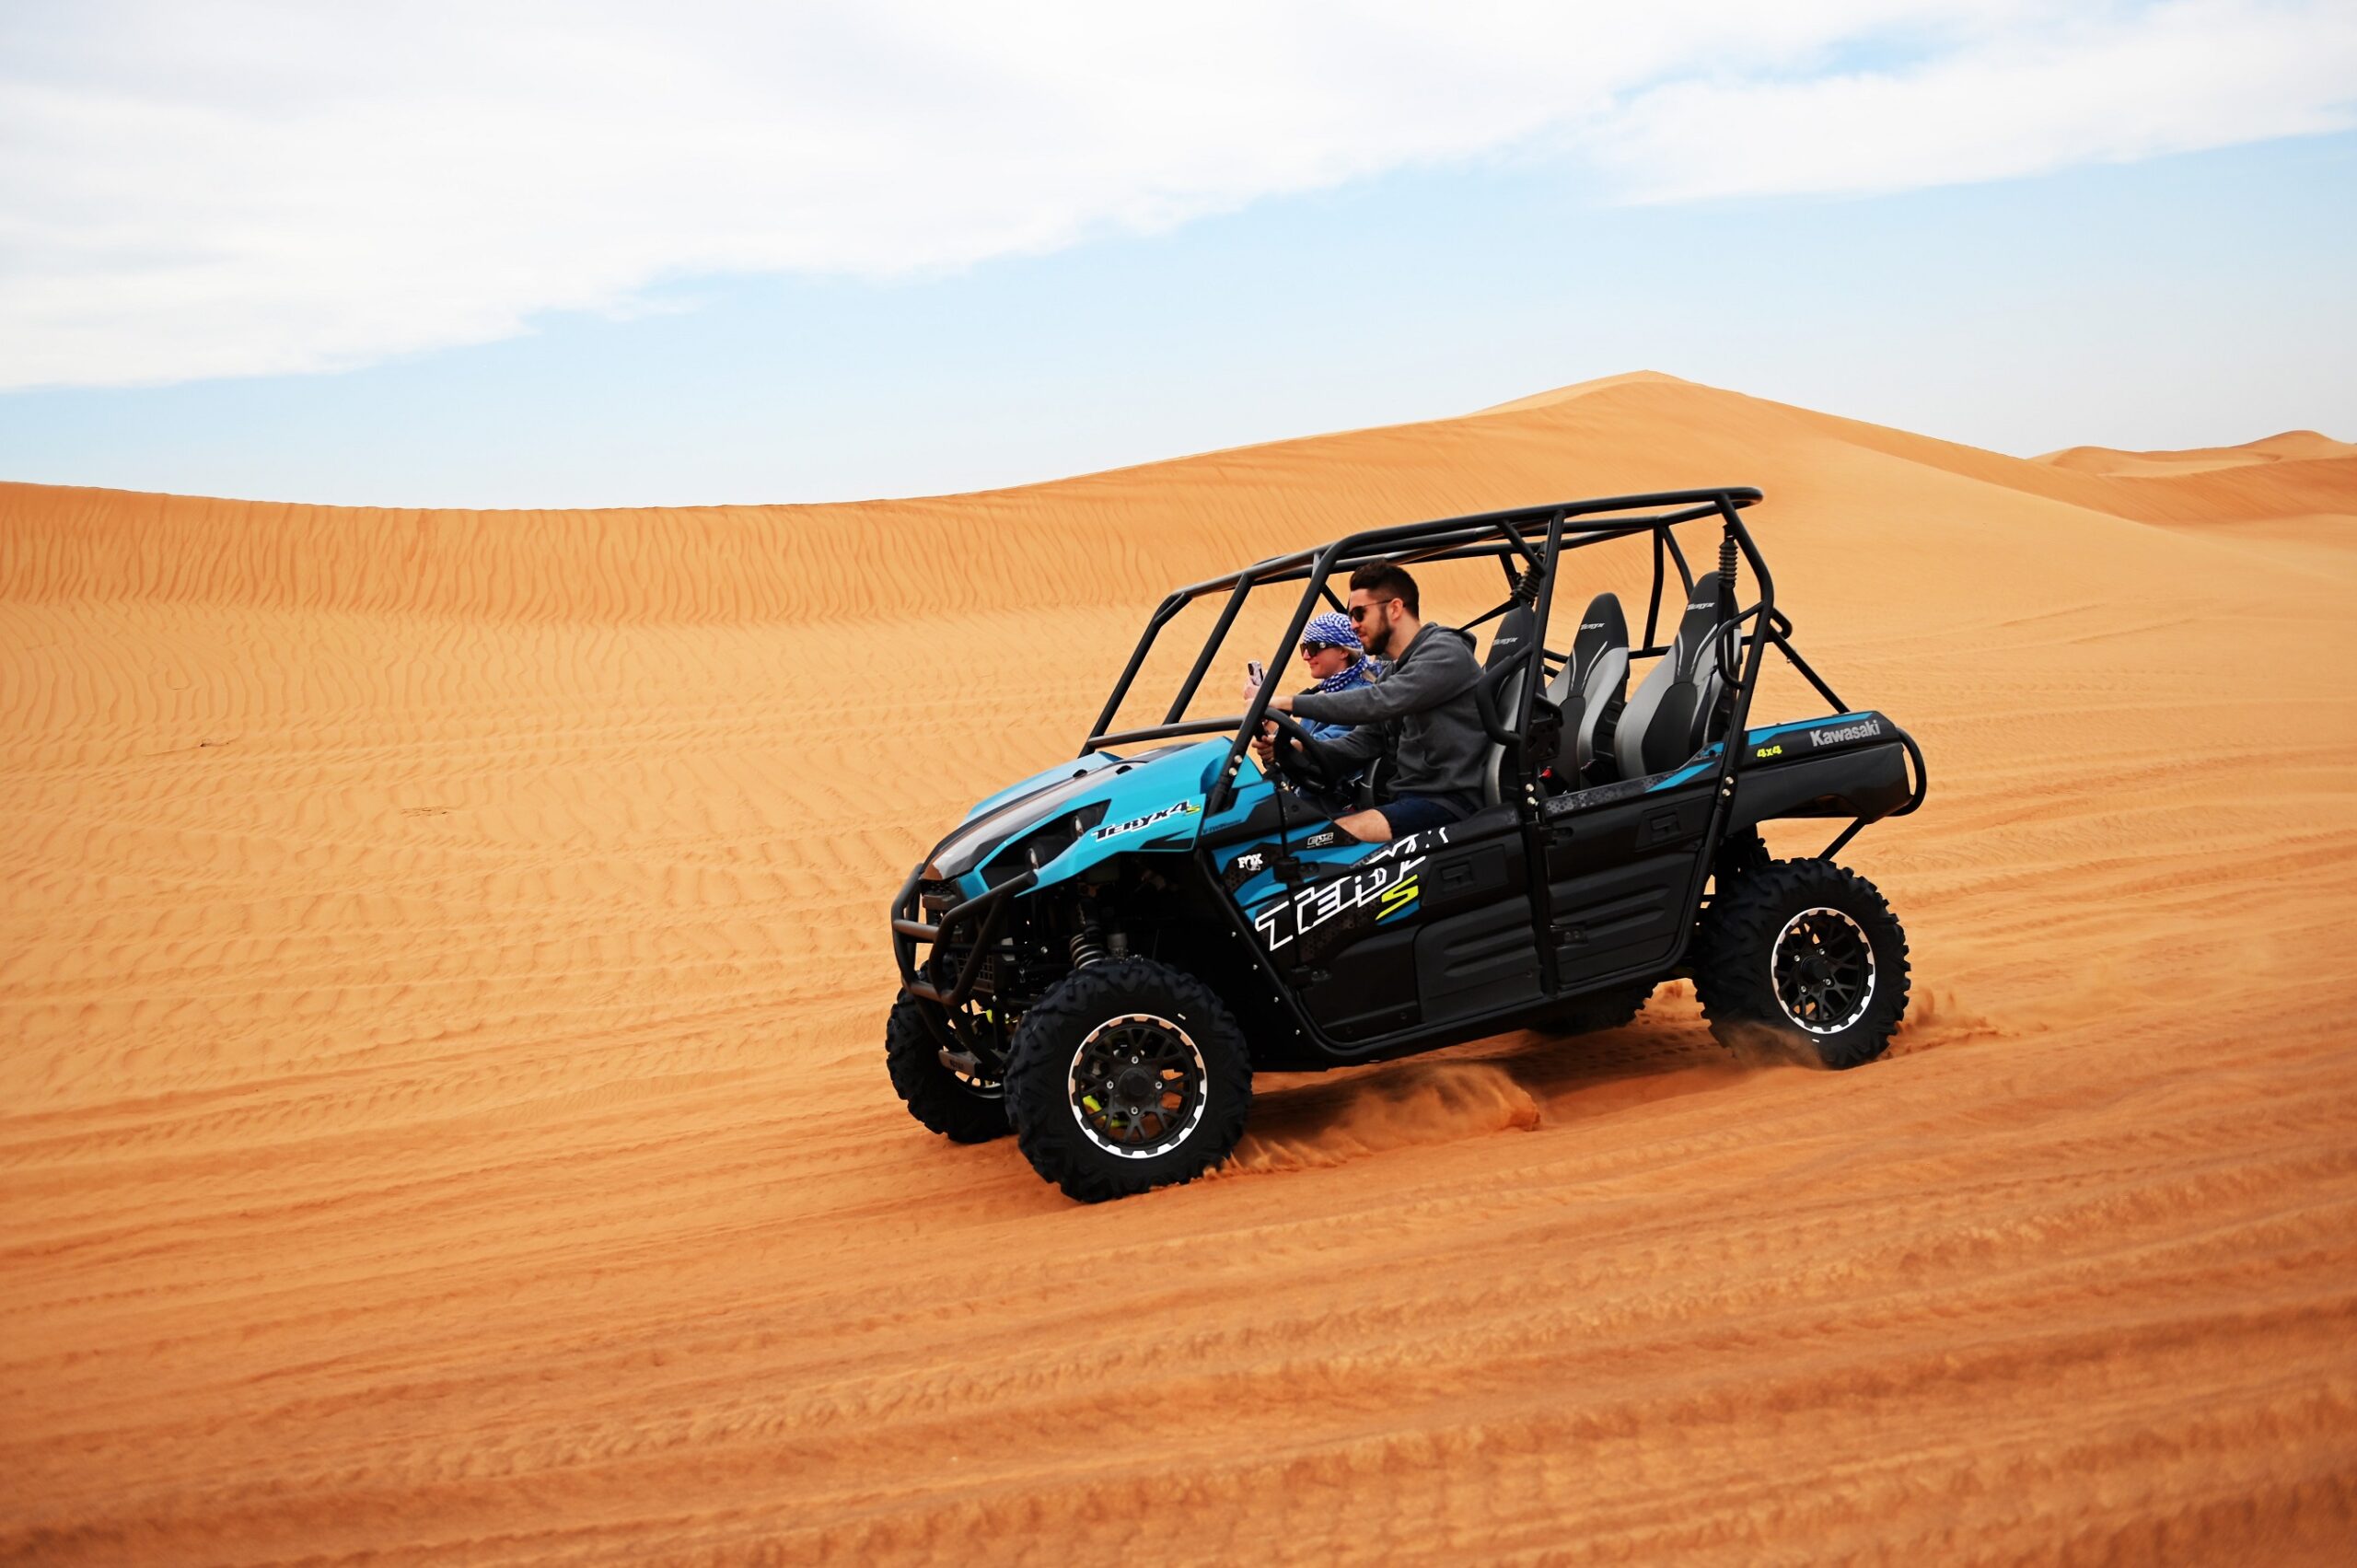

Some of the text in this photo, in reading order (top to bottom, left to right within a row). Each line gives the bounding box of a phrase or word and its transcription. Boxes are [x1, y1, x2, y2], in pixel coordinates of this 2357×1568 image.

[1809, 720, 1881, 748] Kawasaki
[1757, 745, 1782, 758] 4x4
[1237, 853, 1263, 870] FOX
[1375, 874, 1419, 921] S
